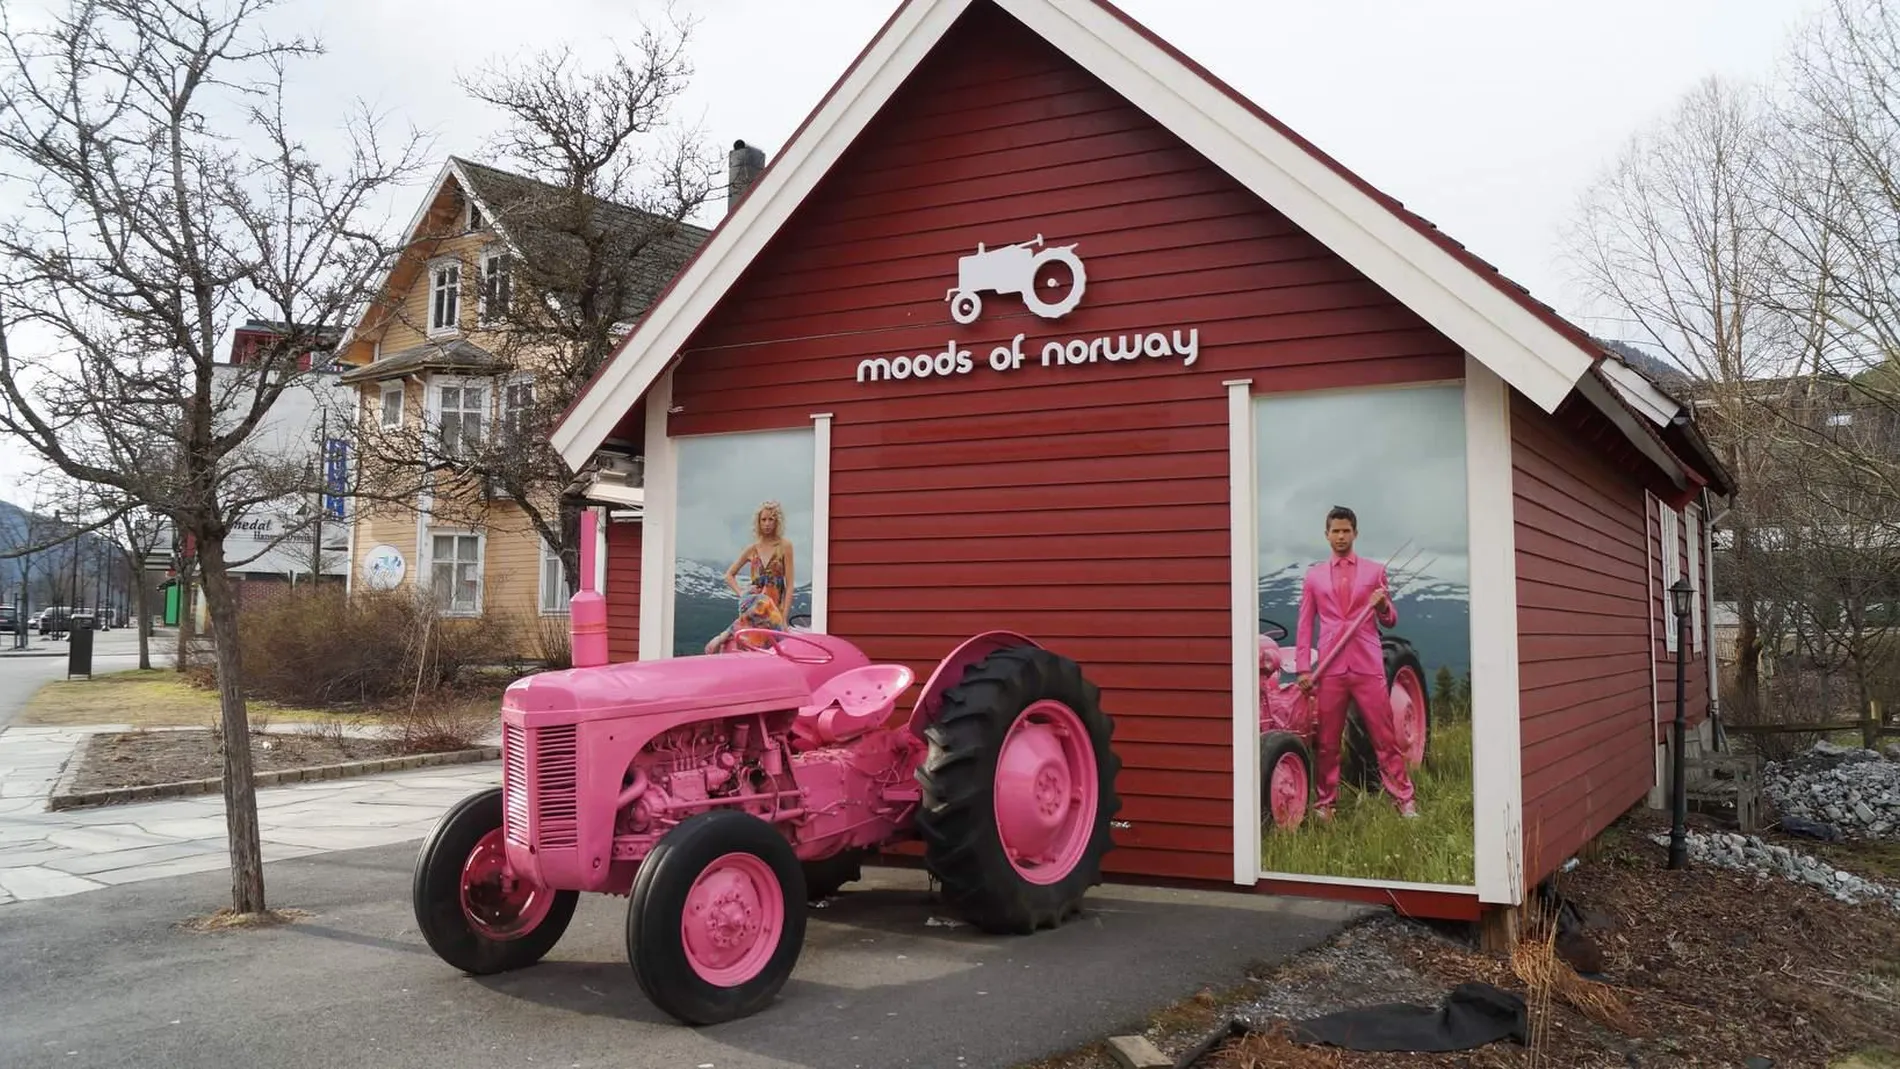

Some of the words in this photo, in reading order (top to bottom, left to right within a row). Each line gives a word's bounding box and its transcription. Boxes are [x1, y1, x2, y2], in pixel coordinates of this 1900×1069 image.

[857, 340, 973, 382] moods
[989, 333, 1026, 371] of
[1042, 328, 1198, 366] norway
